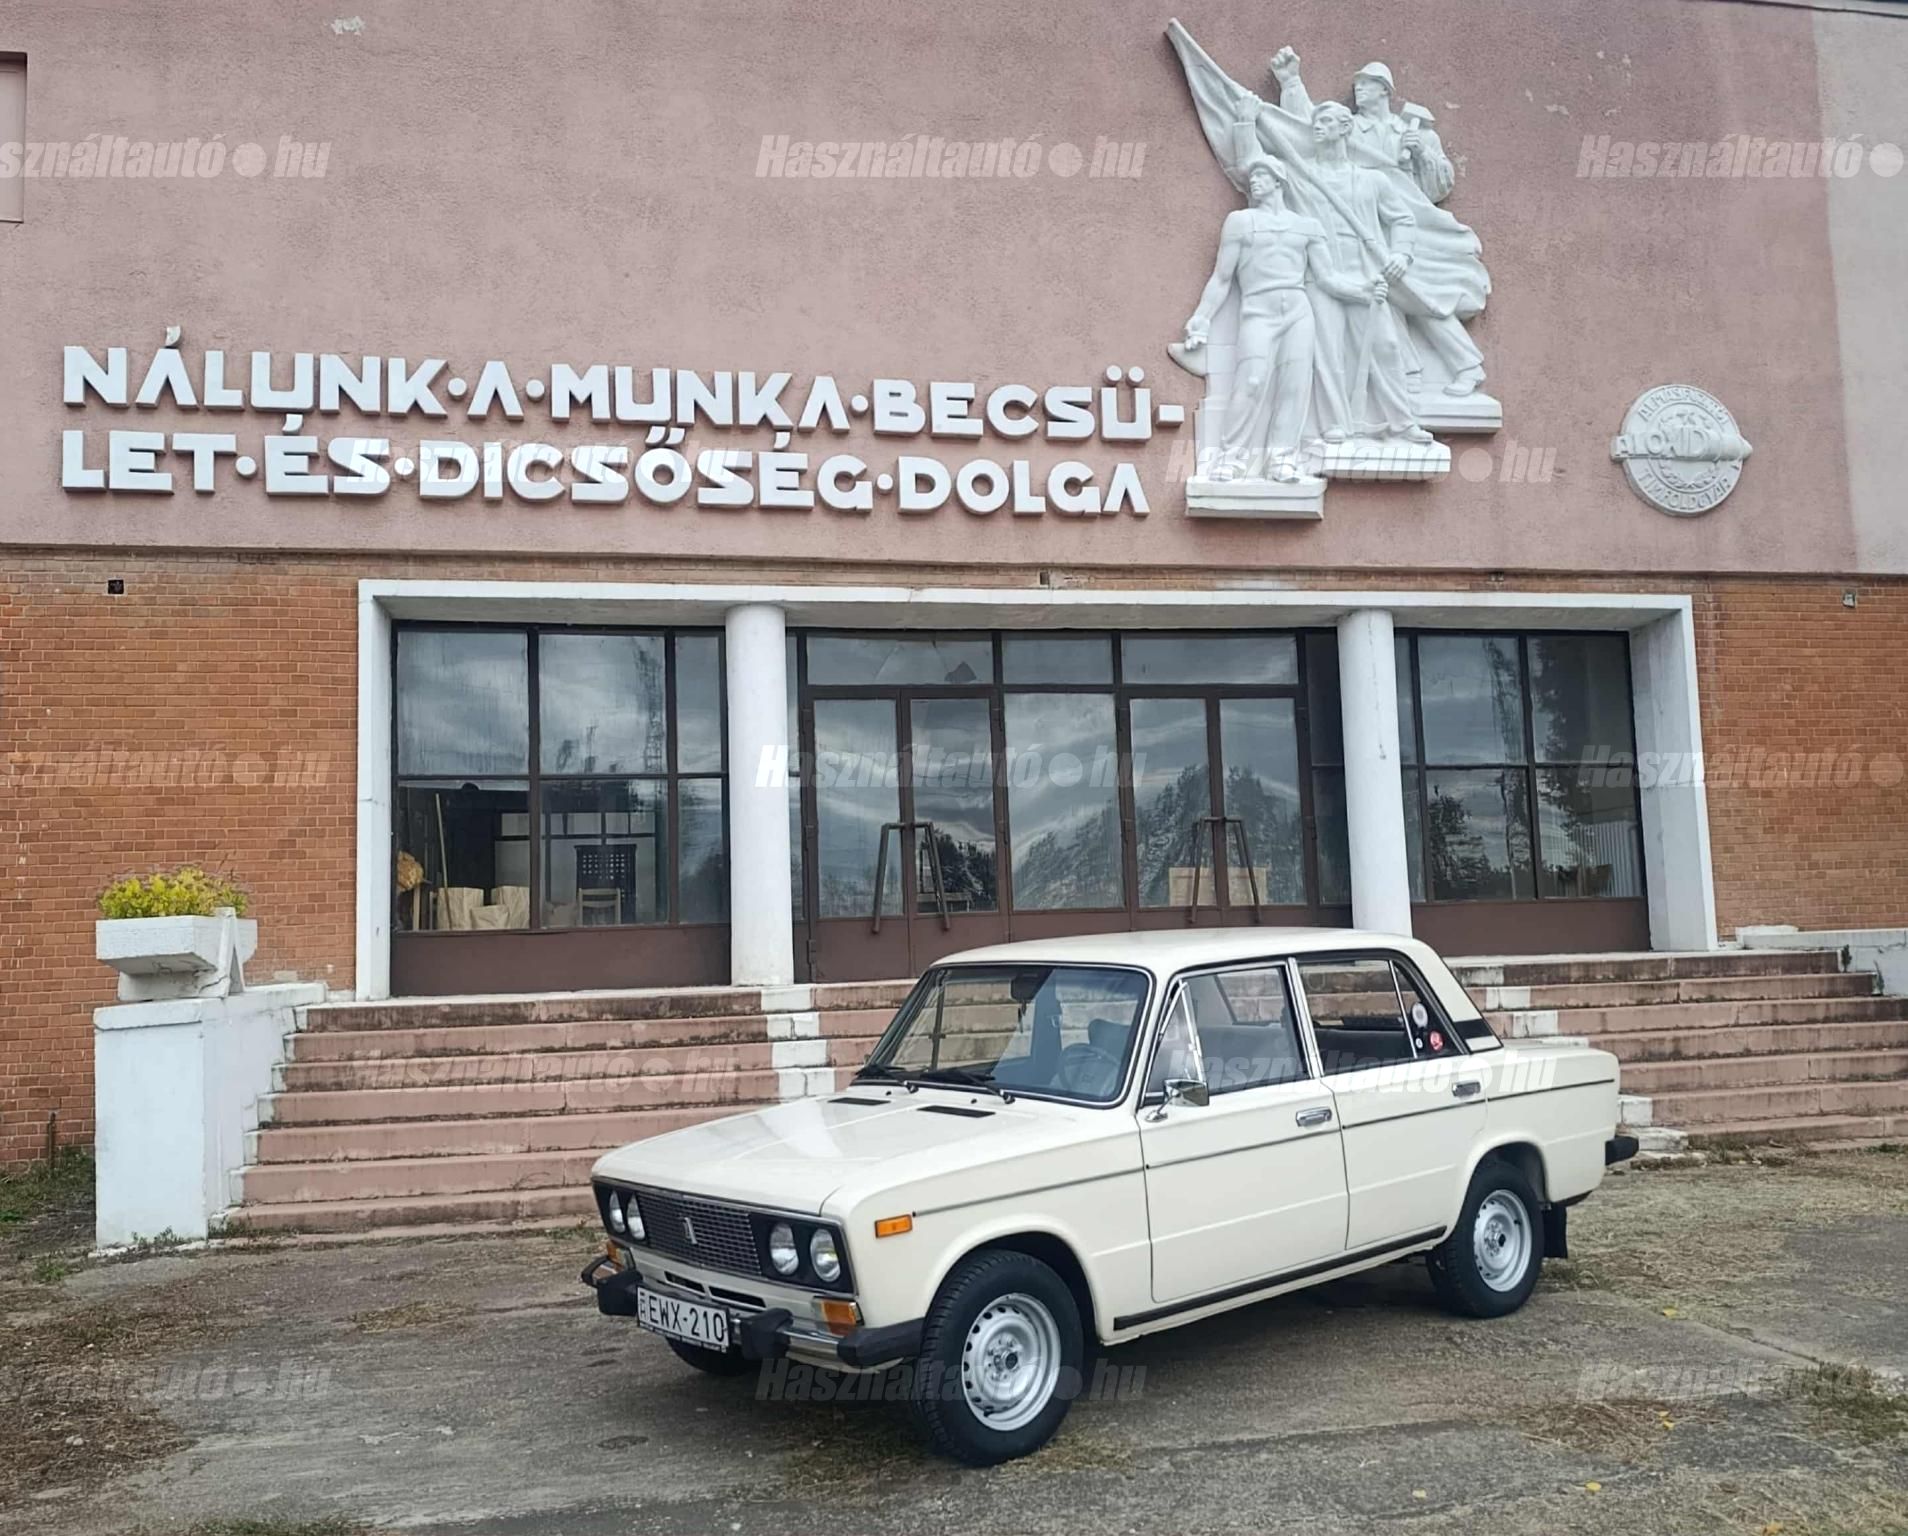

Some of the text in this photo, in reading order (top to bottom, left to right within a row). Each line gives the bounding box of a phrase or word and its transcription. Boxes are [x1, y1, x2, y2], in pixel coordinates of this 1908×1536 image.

[63, 325, 1185, 442] NÁLUNK A MUNKA BECSÜ-
[62, 413, 1150, 517] LET ÉS DICSŐSÉG DOLGA
[648, 1295, 725, 1342] EWX-210
